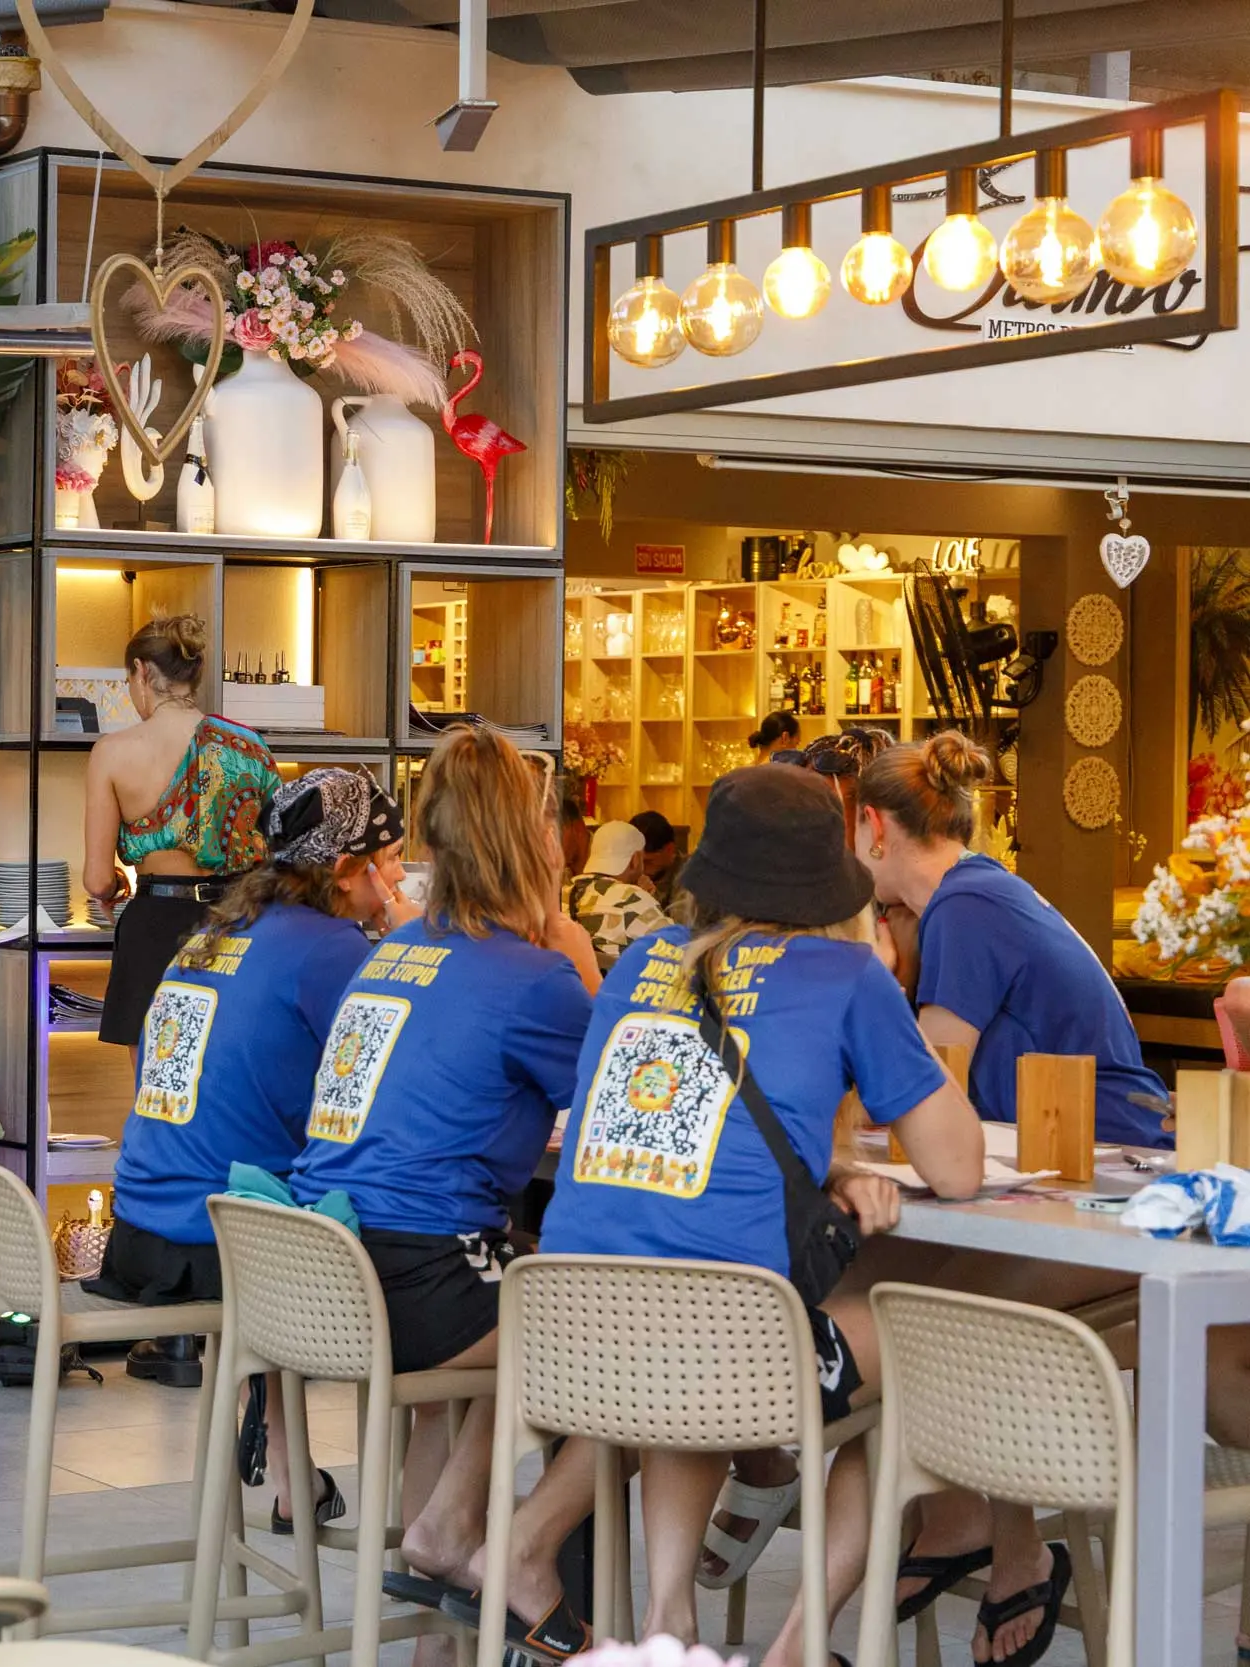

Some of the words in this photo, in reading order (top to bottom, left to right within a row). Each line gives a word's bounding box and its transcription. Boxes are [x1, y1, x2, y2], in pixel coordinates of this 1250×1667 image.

[653, 552, 683, 569] SALIDA
[932, 537, 982, 573] LOVE
[388, 963, 439, 987] STUPID
